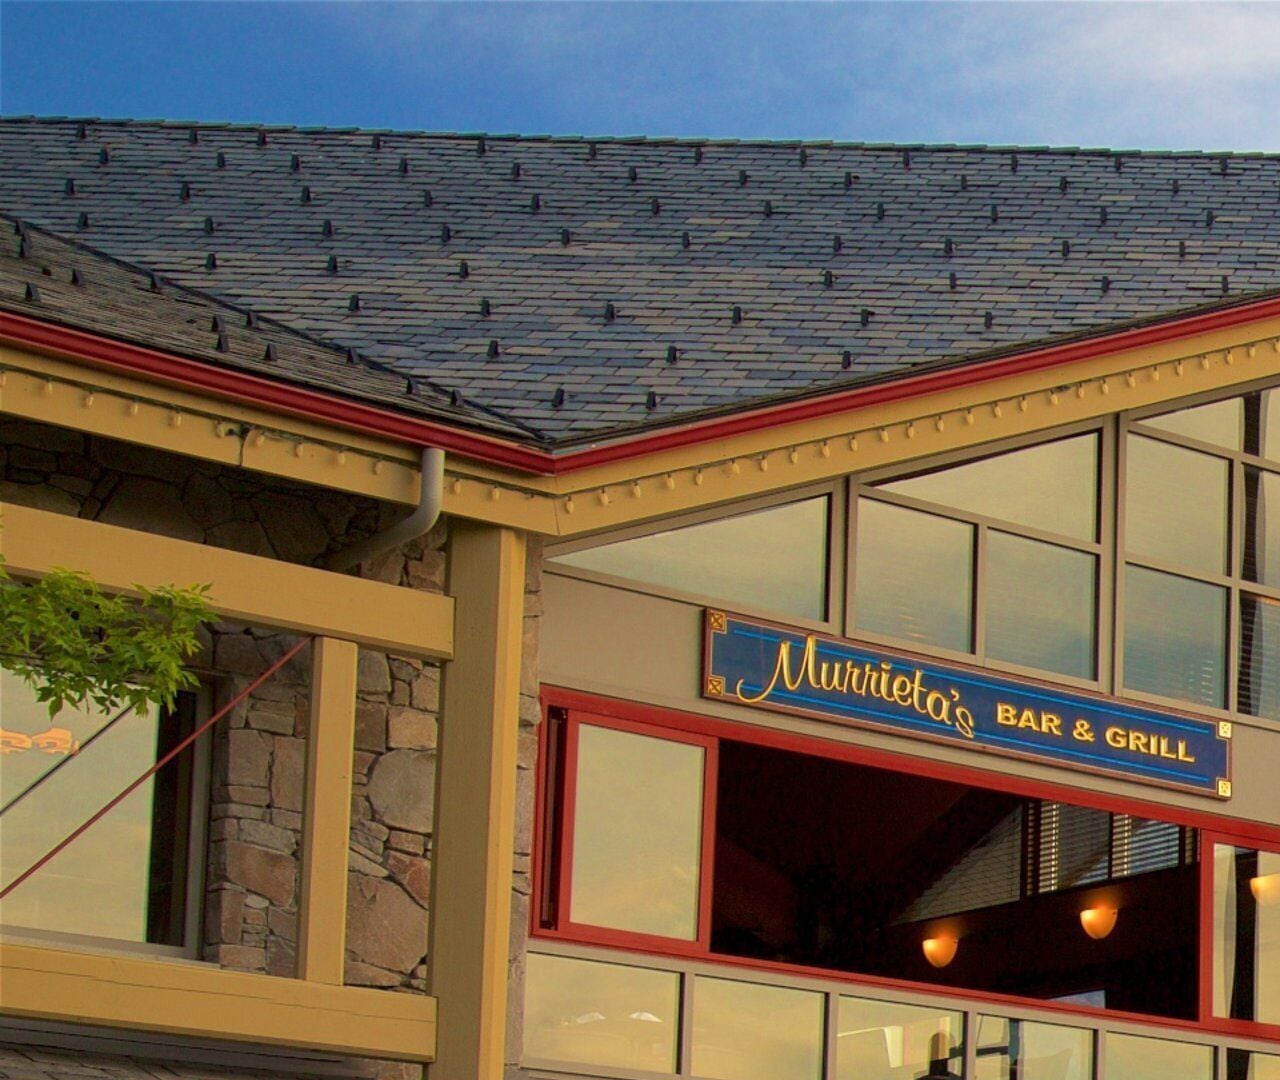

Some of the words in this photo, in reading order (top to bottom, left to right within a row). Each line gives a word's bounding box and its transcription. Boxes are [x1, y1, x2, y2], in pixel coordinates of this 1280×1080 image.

[736, 633, 976, 739] Murrieta's
[995, 701, 1062, 736] BAR
[1072, 719, 1096, 743] &
[1104, 726, 1197, 764] GRILL
